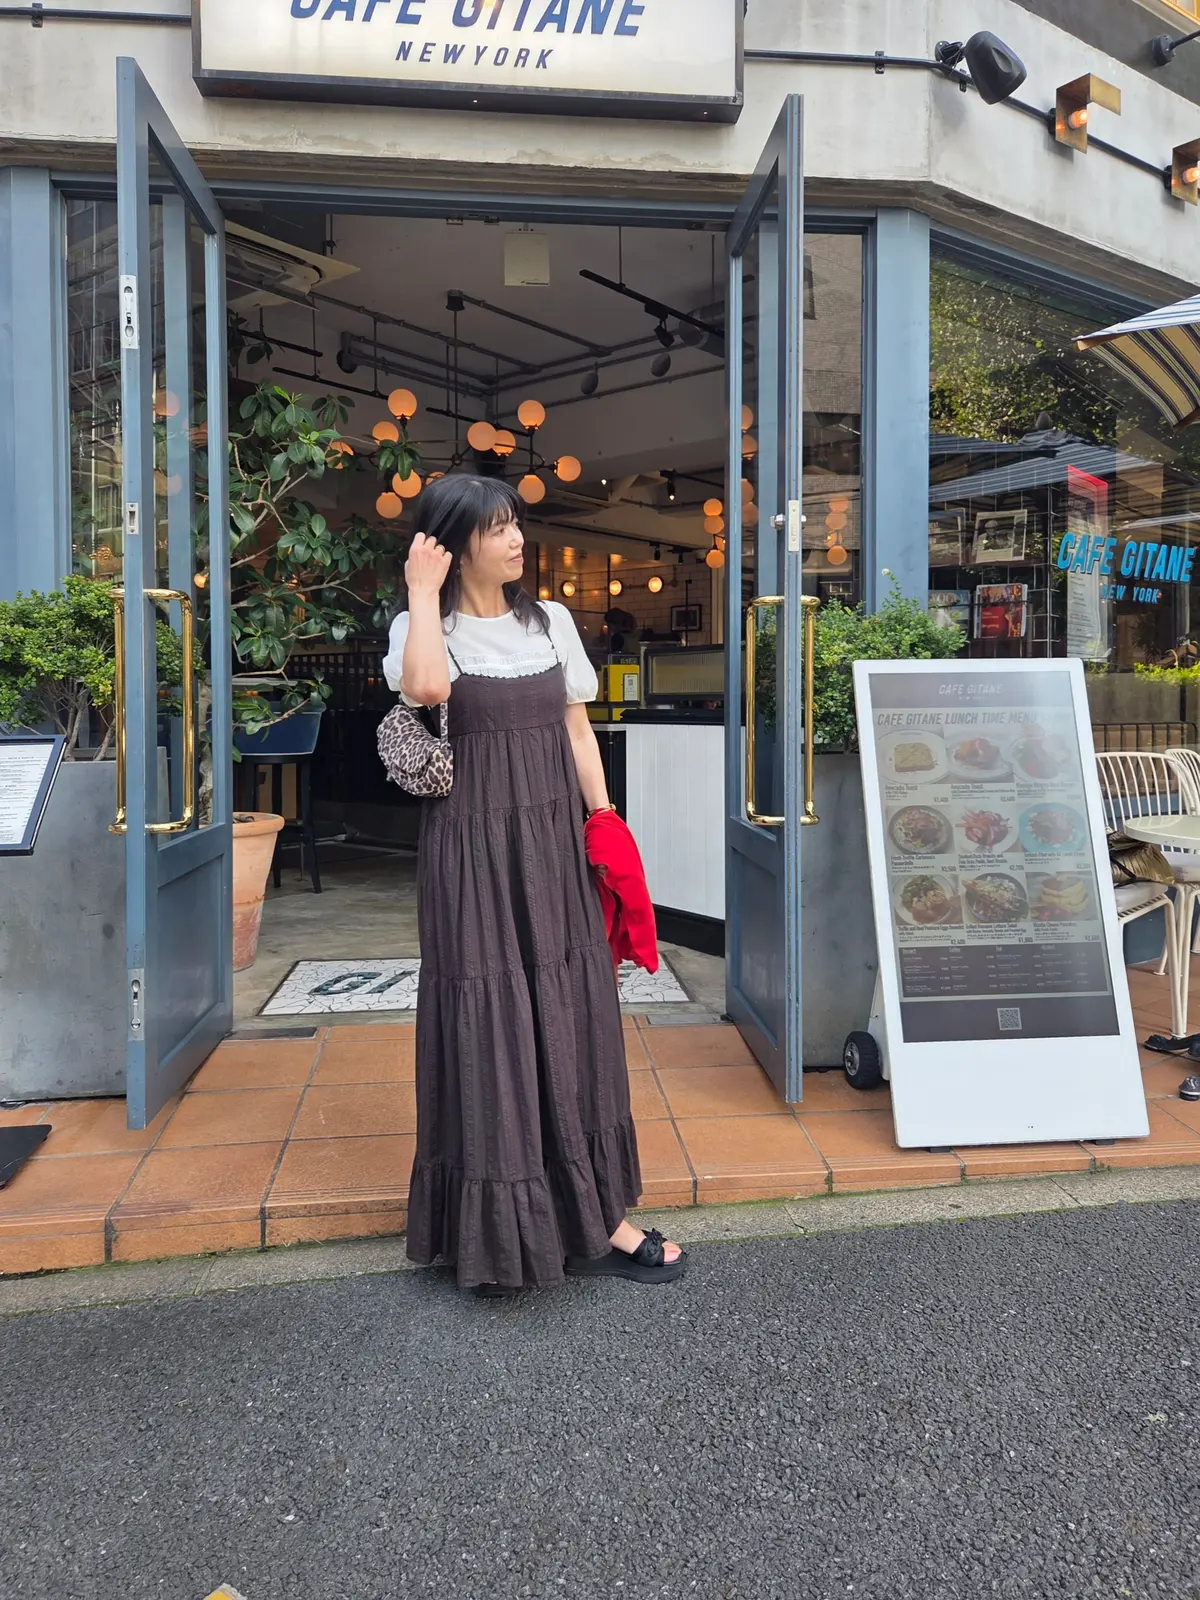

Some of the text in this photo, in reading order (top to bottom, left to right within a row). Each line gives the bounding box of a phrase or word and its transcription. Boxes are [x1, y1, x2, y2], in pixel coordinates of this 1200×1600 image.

[1057, 532, 1196, 584] CAFE GITANE
[1101, 583, 1160, 604] NEW YORK
[939, 684, 1002, 695] CAFE GITANE
[877, 713, 904, 726] CAFE
[906, 712, 942, 725] GITANE
[944, 712, 978, 725] LUNCH
[981, 712, 1006, 724] TIME
